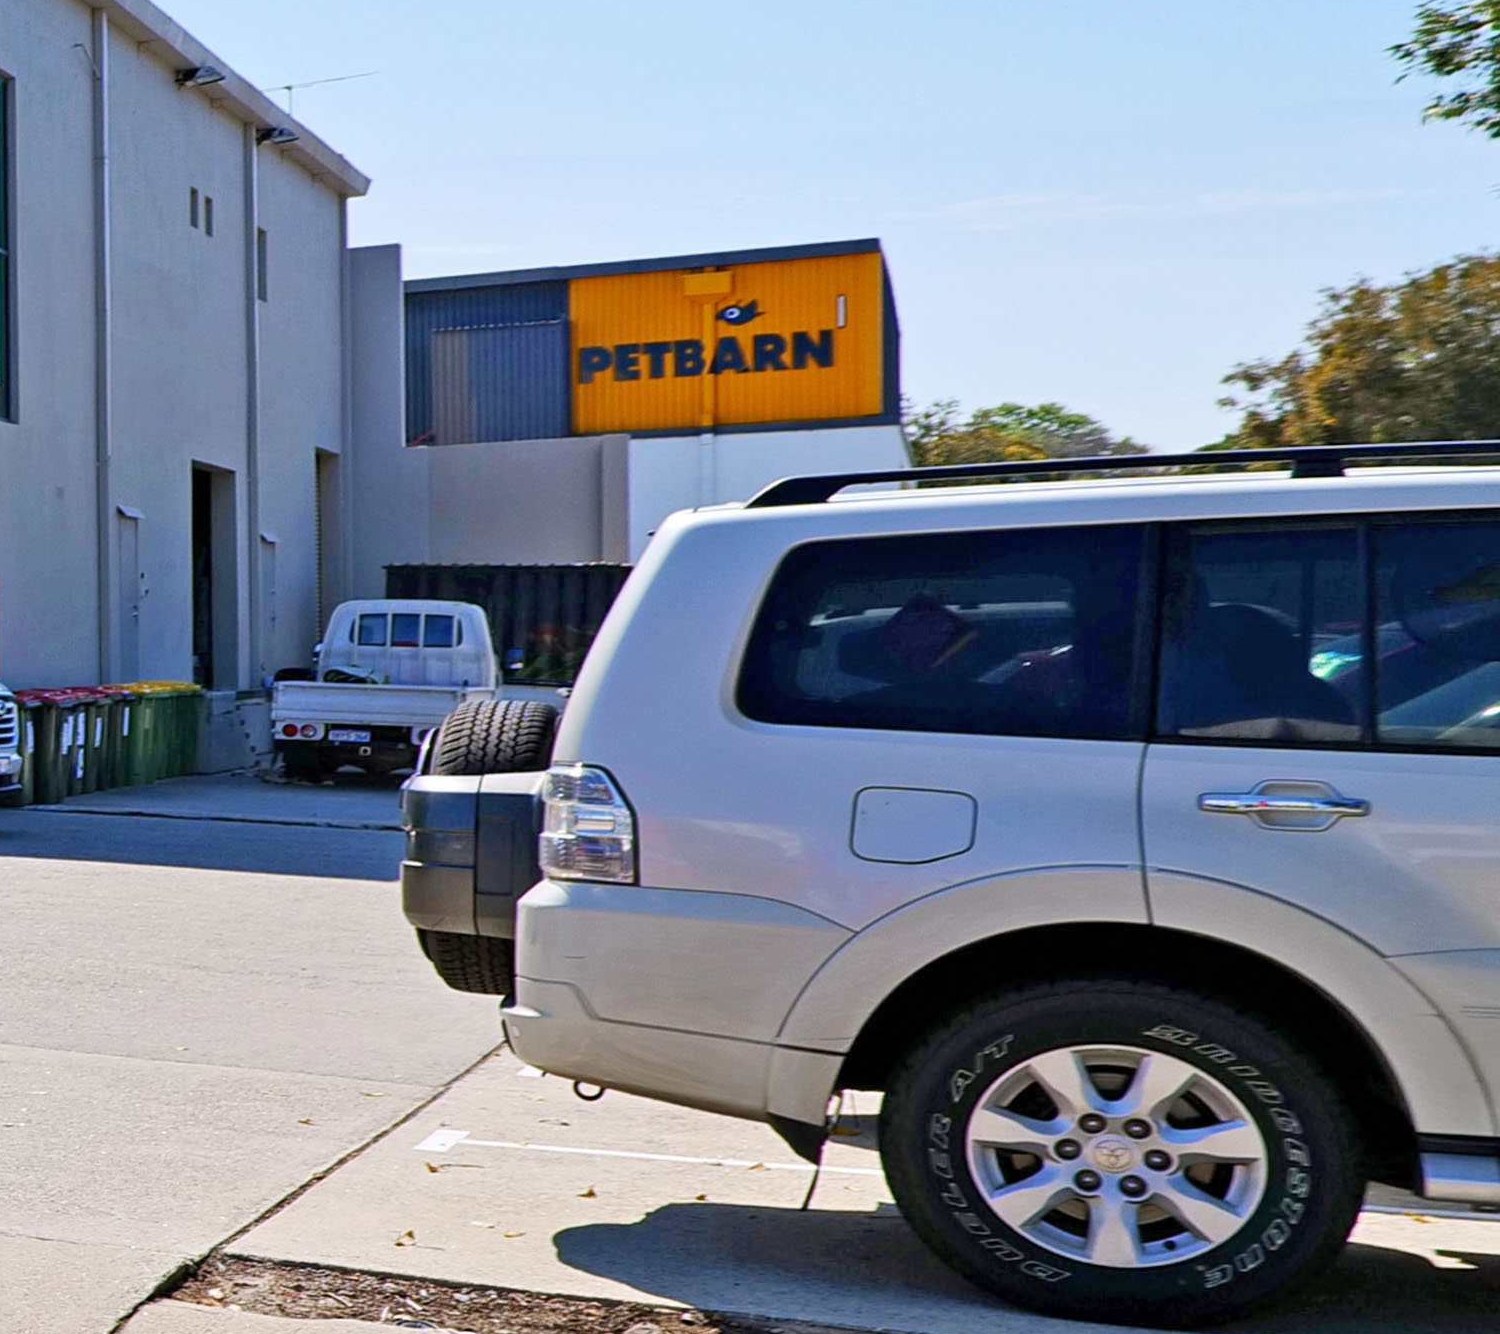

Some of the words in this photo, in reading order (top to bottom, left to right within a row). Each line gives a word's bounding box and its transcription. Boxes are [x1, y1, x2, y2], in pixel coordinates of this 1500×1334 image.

[578, 329, 835, 384] PETBARN
[951, 1034, 1015, 1104] A/T
[929, 1112, 1072, 1283] DUELER
